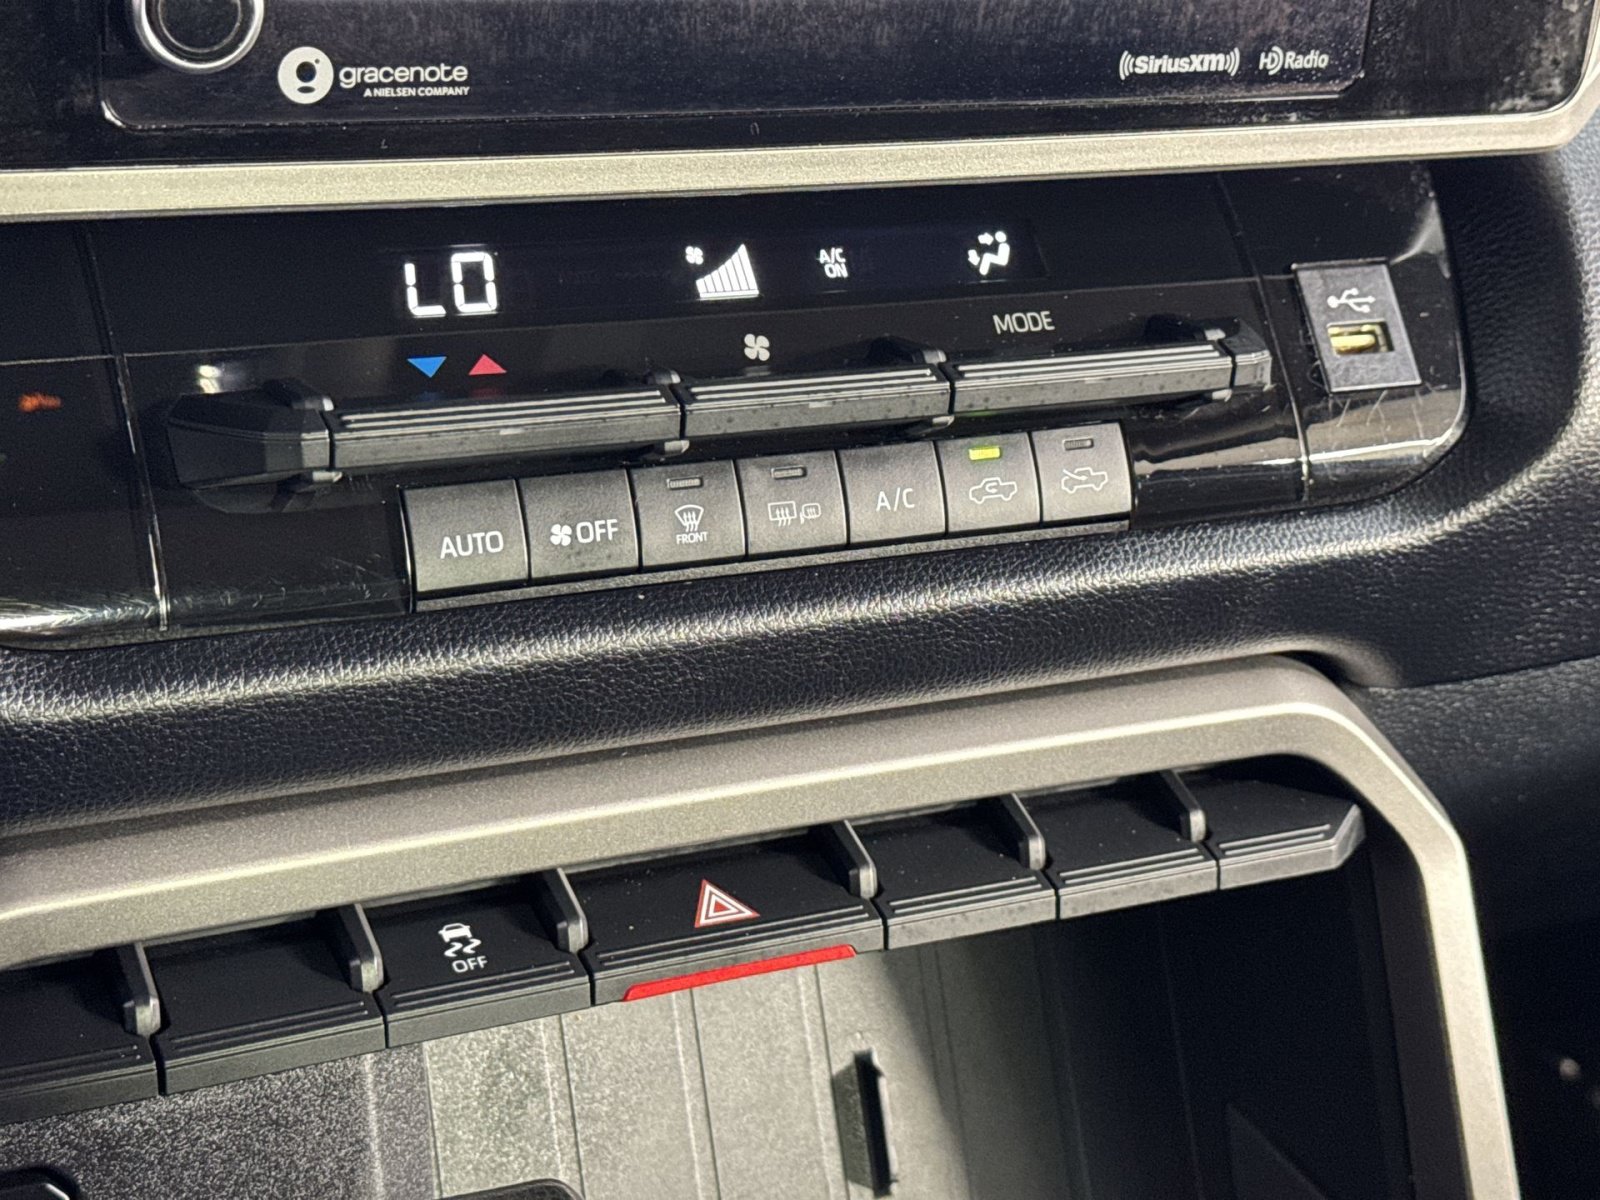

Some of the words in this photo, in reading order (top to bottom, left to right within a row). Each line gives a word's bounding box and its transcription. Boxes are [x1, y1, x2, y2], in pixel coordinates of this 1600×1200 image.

[1284, 49, 1330, 70] Radio
[338, 63, 469, 89] gracenote
[363, 88, 373, 97] A
[373, 87, 417, 97] NIELSEN
[417, 86, 470, 96] COMPANY
[819, 247, 847, 264] A/C
[824, 262, 849, 279] ON
[992, 310, 1056, 335] MODE
[875, 487, 916, 512] A/C
[575, 518, 619, 543] OFF
[675, 531, 709, 545] FRONT
[439, 530, 504, 559] AUTO
[451, 955, 488, 973] OFF
